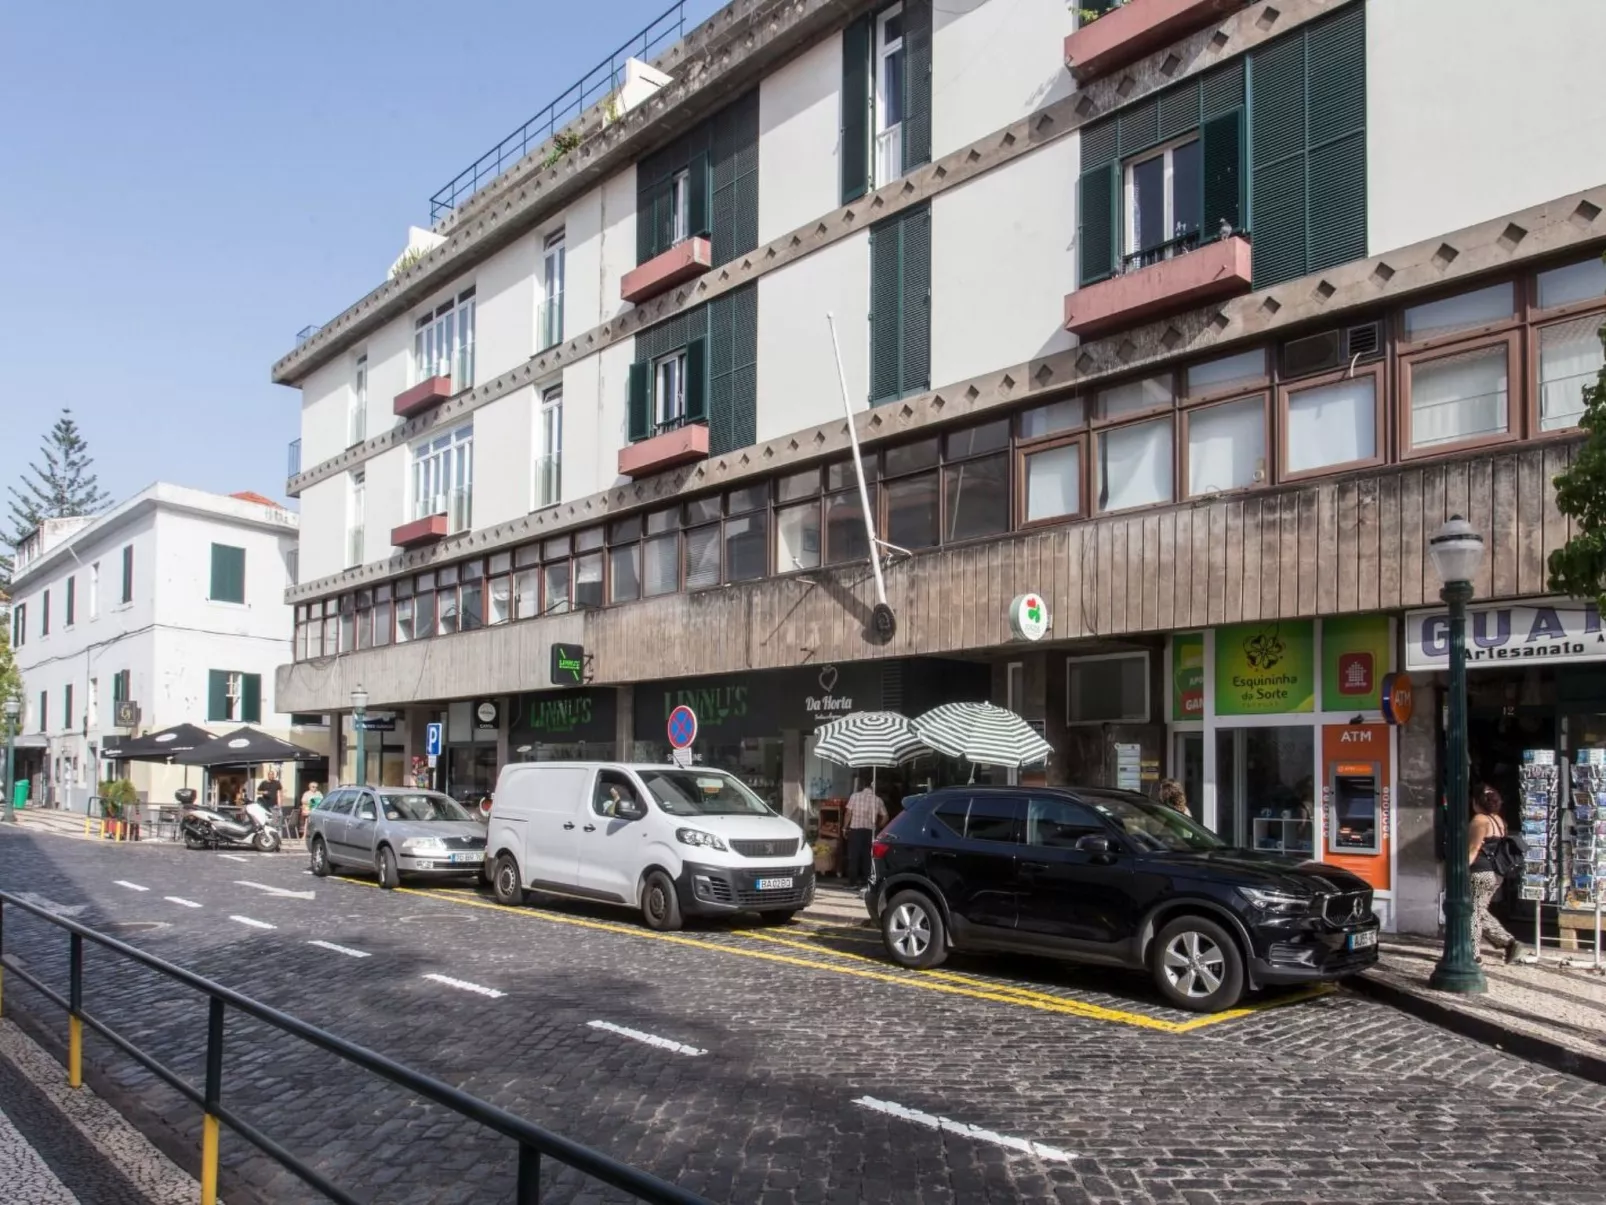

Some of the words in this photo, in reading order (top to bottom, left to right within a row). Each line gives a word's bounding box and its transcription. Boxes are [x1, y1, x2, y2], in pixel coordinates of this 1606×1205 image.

[1464, 641, 1584, 660] Artesanato
[1233, 674, 1298, 689] Esquininha
[806, 696, 821, 711] Da
[822, 694, 852, 710] Horta
[1241, 691, 1254, 701] da
[1256, 688, 1288, 700] Sorte
[1395, 690, 1411, 706] ATM
[428, 726, 437, 754] P
[1341, 731, 1372, 742] ATM
